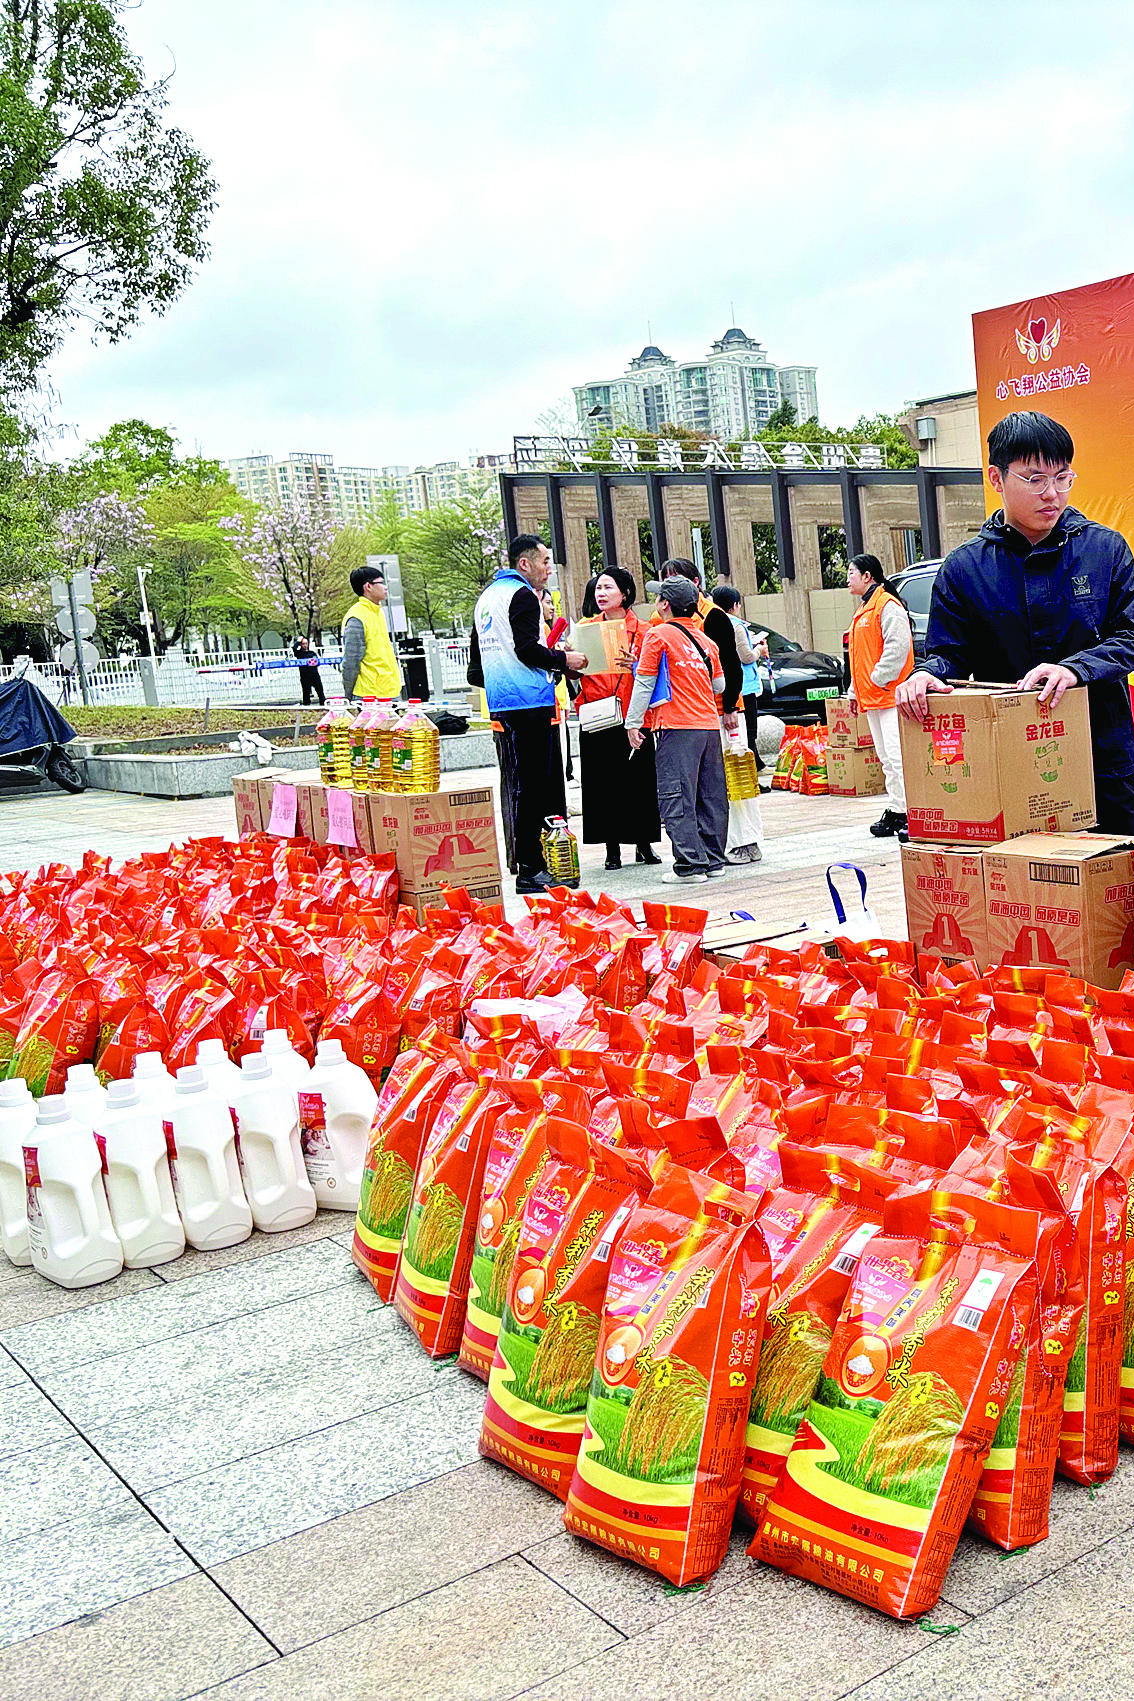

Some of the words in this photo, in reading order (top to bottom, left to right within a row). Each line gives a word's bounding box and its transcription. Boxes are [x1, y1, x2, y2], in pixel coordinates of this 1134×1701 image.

[996, 363, 1091, 401] 心飞翔公益协会
[923, 713, 966, 732] 金龙鱼
[1025, 720, 1065, 741] 金龙鱼
[916, 876, 952, 891] 加油中国
[932, 891, 969, 907] 品质是金
[990, 900, 1031, 920] 加油中国
[1035, 905, 1080, 927] 品质是金
[533, 1186, 571, 1210] 世界春
[543, 1209, 606, 1318] 茉莉香米
[622, 1239, 666, 1265] 世界春
[864, 1253, 912, 1282] 世界春
[634, 1265, 717, 1377] 茉莉香米
[885, 1276, 960, 1391] 茉莉香米
